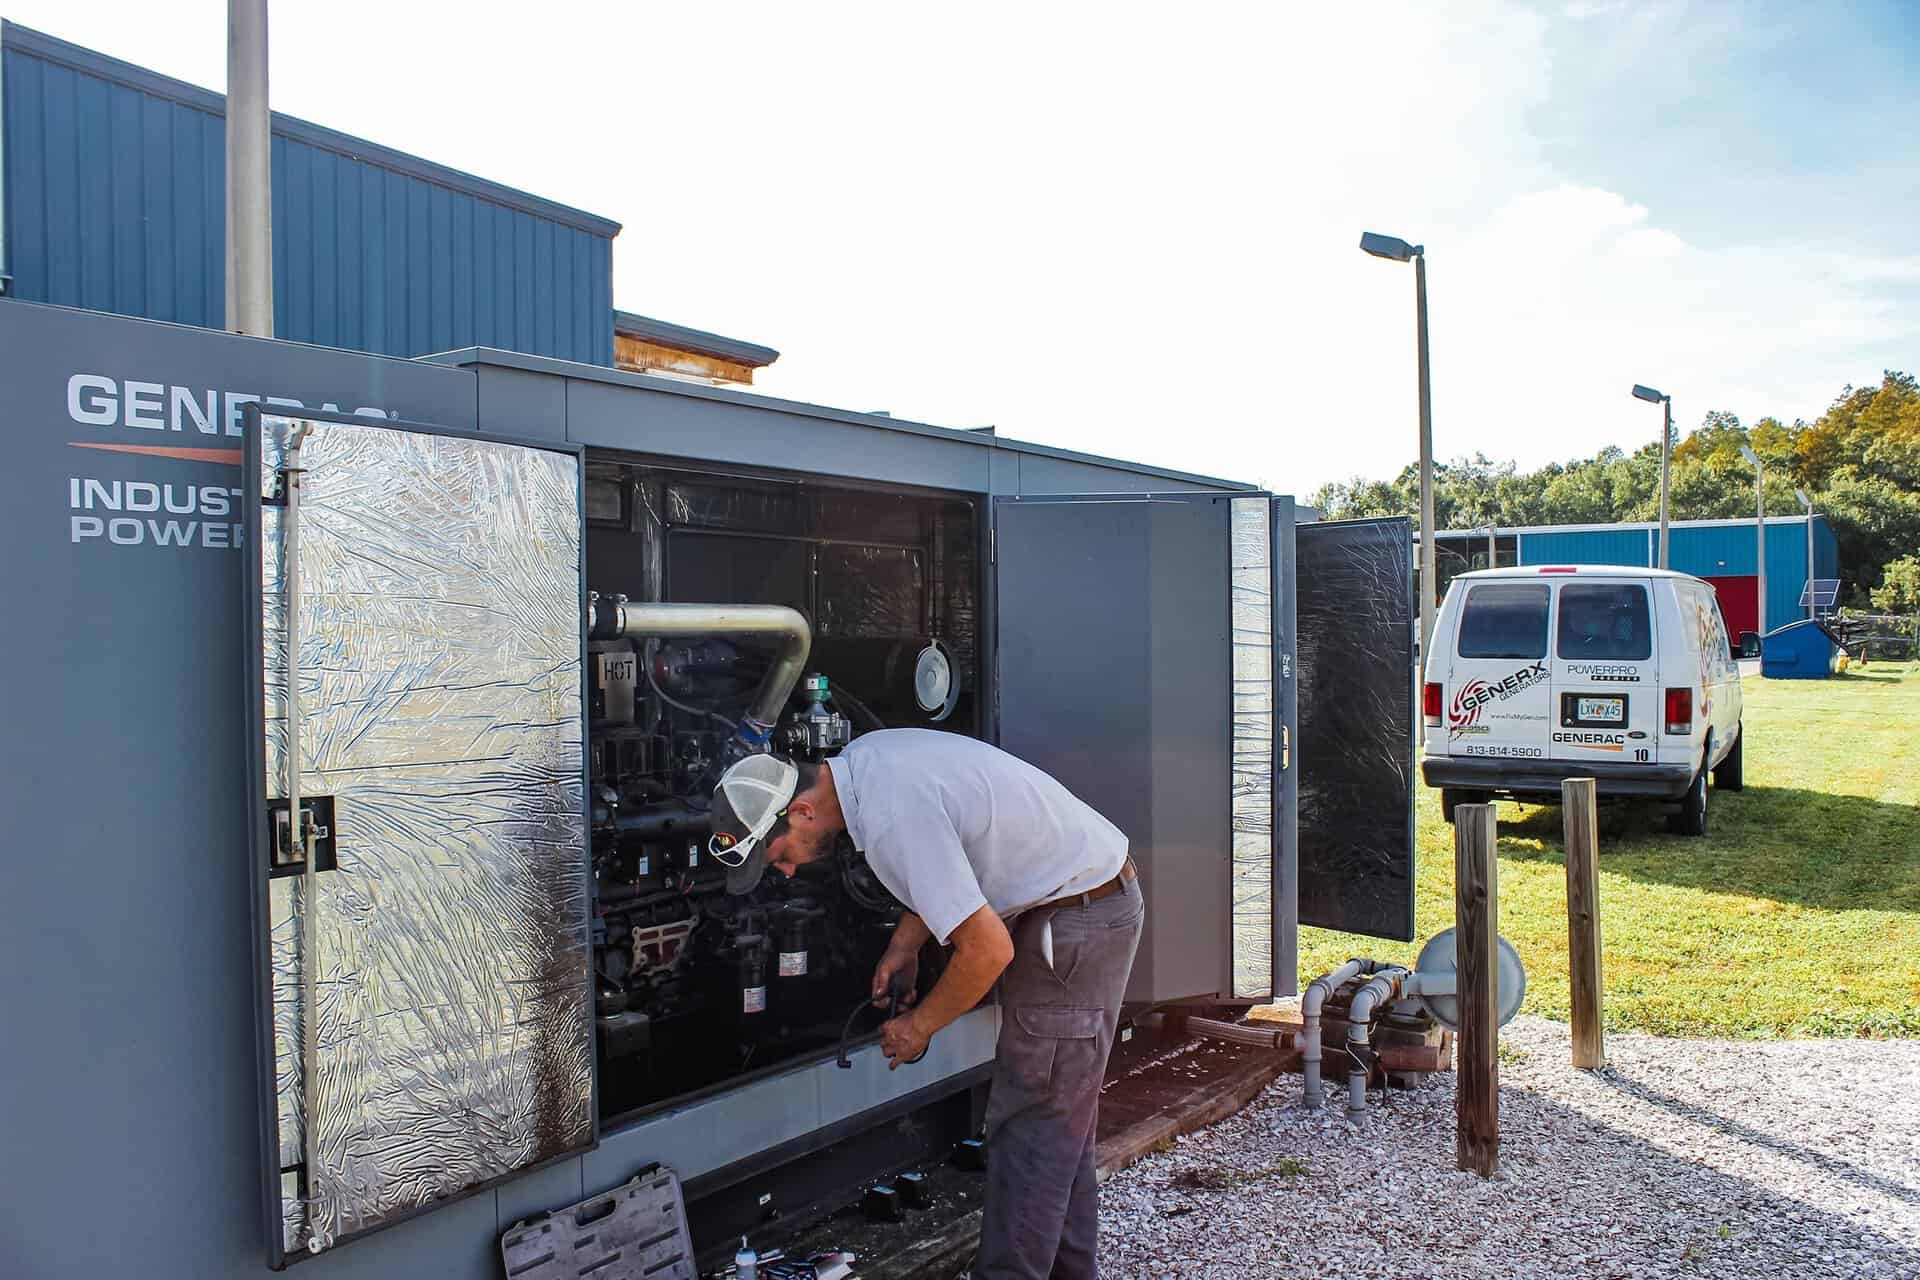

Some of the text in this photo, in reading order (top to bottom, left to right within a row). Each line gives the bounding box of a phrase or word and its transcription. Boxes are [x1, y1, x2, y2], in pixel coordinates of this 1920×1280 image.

[67, 373, 387, 436] GENE
[70, 477, 244, 516] INDUS
[604, 660, 633, 681] HOT
[1567, 664, 1637, 675] POWERPRO
[1462, 660, 1547, 711] GENERX
[1499, 670, 1552, 701] GENERATORS
[1552, 732, 1625, 744] GENERAC
[1466, 745, 1542, 758] 813-814-5900
[1634, 748, 1649, 762] 10
